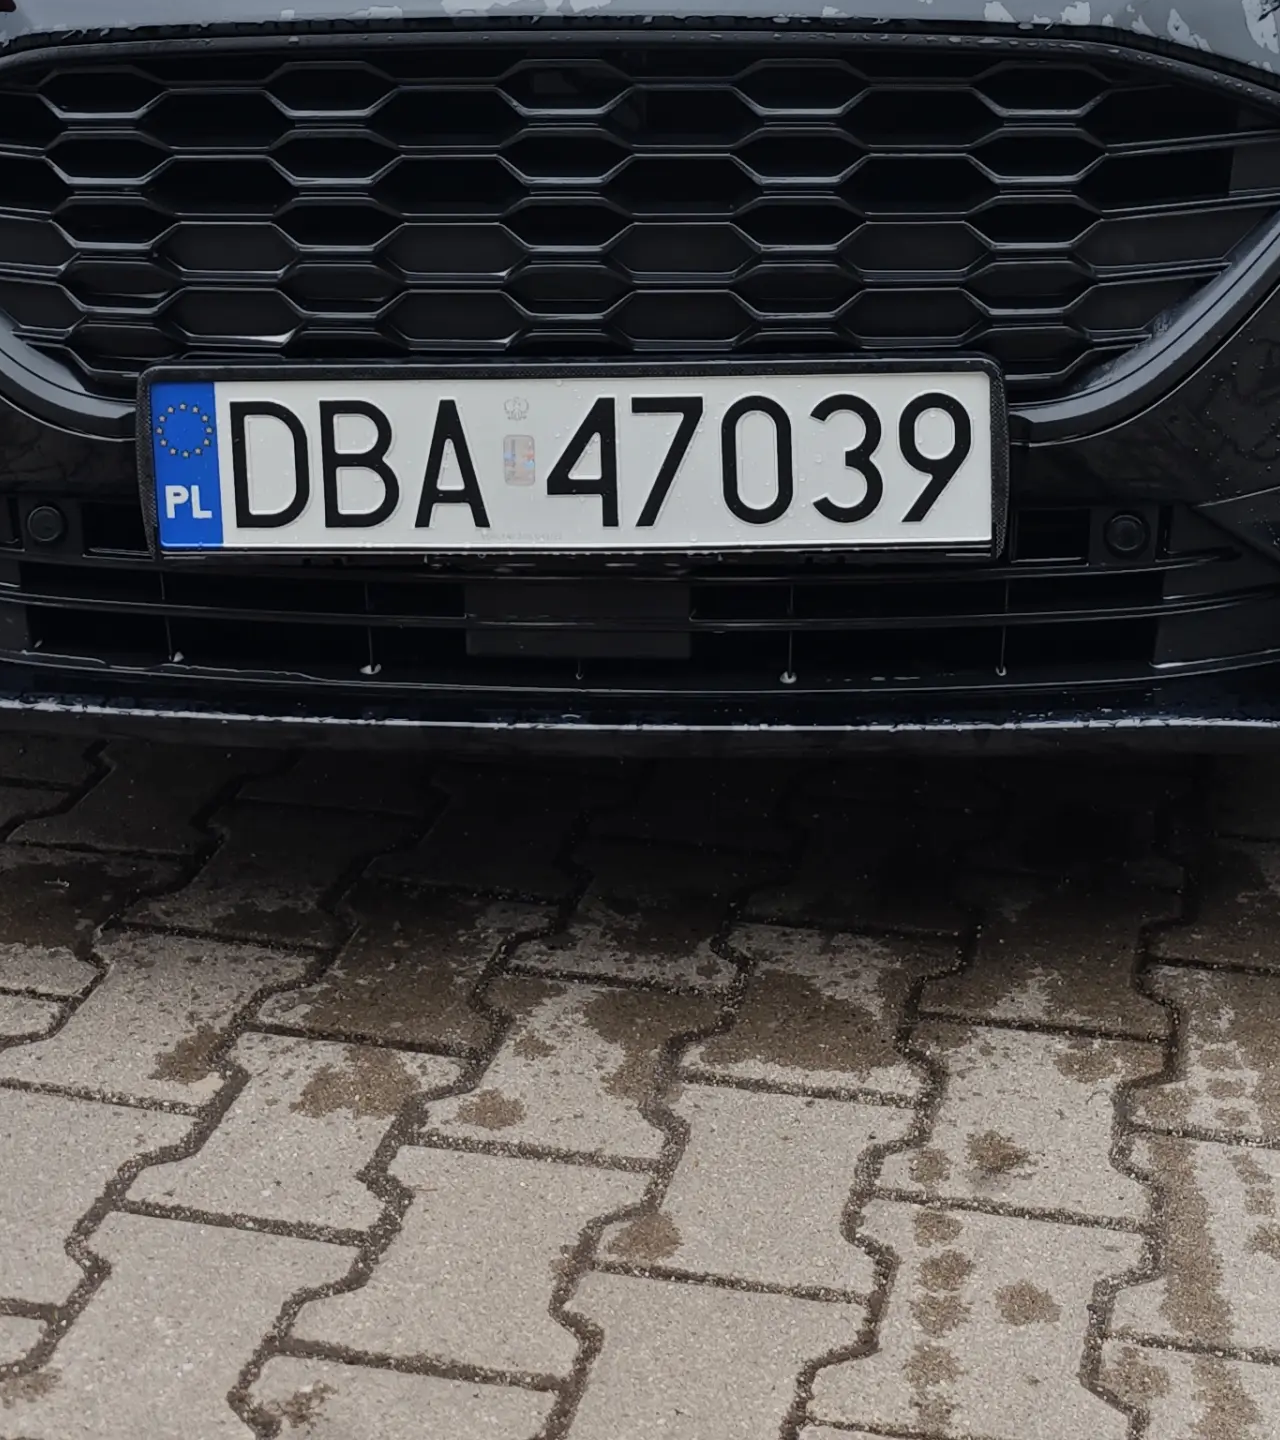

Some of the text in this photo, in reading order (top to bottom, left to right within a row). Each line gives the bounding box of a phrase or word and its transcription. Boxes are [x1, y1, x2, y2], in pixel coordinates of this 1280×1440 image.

[165, 484, 213, 519] PL
[229, 392, 972, 529] DBA 47039
